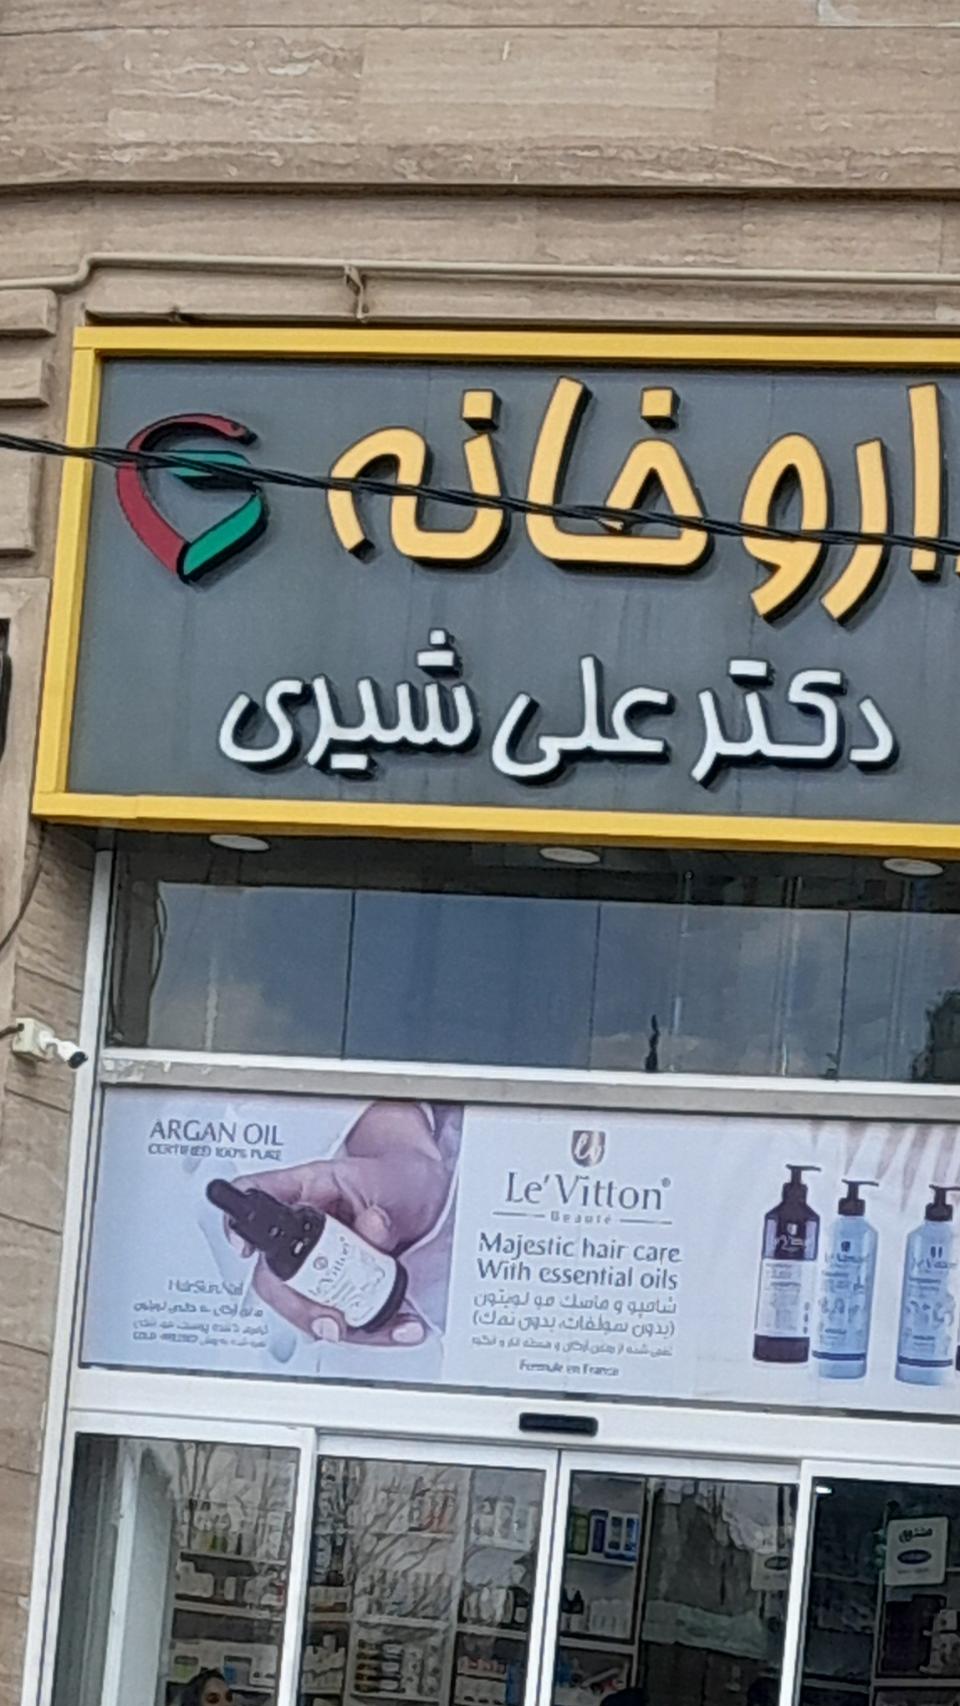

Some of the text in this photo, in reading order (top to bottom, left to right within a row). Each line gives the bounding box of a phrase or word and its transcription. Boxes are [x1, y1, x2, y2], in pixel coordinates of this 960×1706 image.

[218, 629, 898, 786] دکتر علی شیری
[150, 1119, 284, 1146] ARGAN OIL
[479, 1232, 682, 1263] Majestic hair care
[477, 1258, 678, 1290] With essential oils
[534, 1295, 555, 1310] مو
[559, 1294, 609, 1311] ماسک
[614, 1300, 622, 1315] و
[627, 1296, 676, 1317] شامپو
[518, 1315, 556, 1333] بدون
